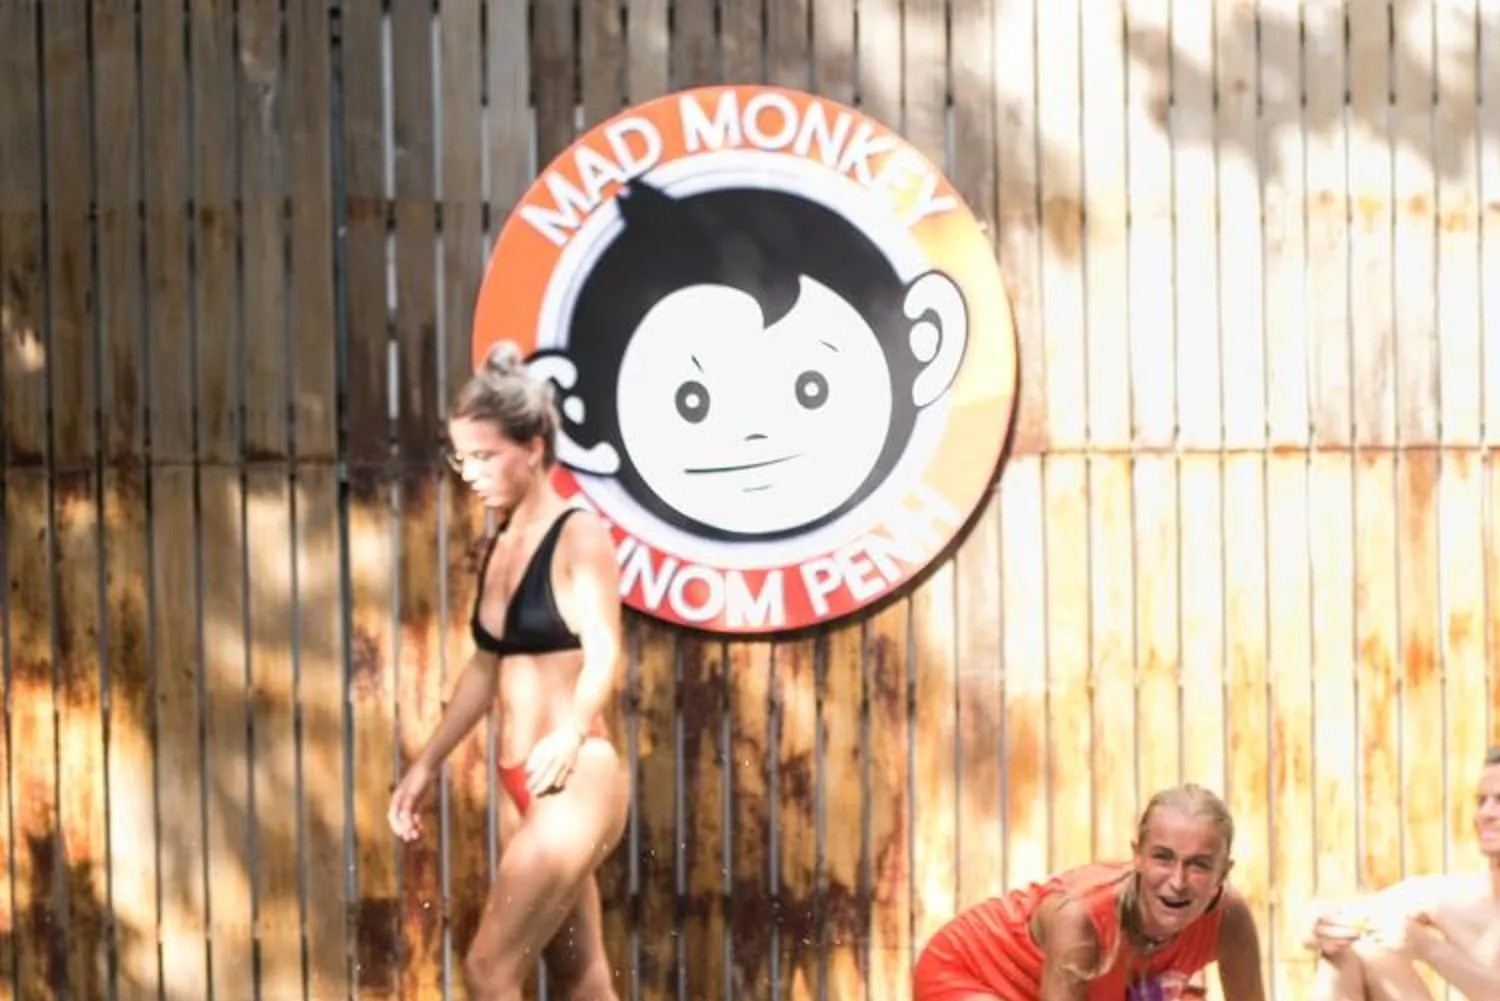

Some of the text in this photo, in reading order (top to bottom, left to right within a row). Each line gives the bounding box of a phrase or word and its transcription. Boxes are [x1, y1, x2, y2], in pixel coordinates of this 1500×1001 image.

[519, 91, 957, 246] MAD MONKEY
[590, 482, 964, 627] NOM PENH
